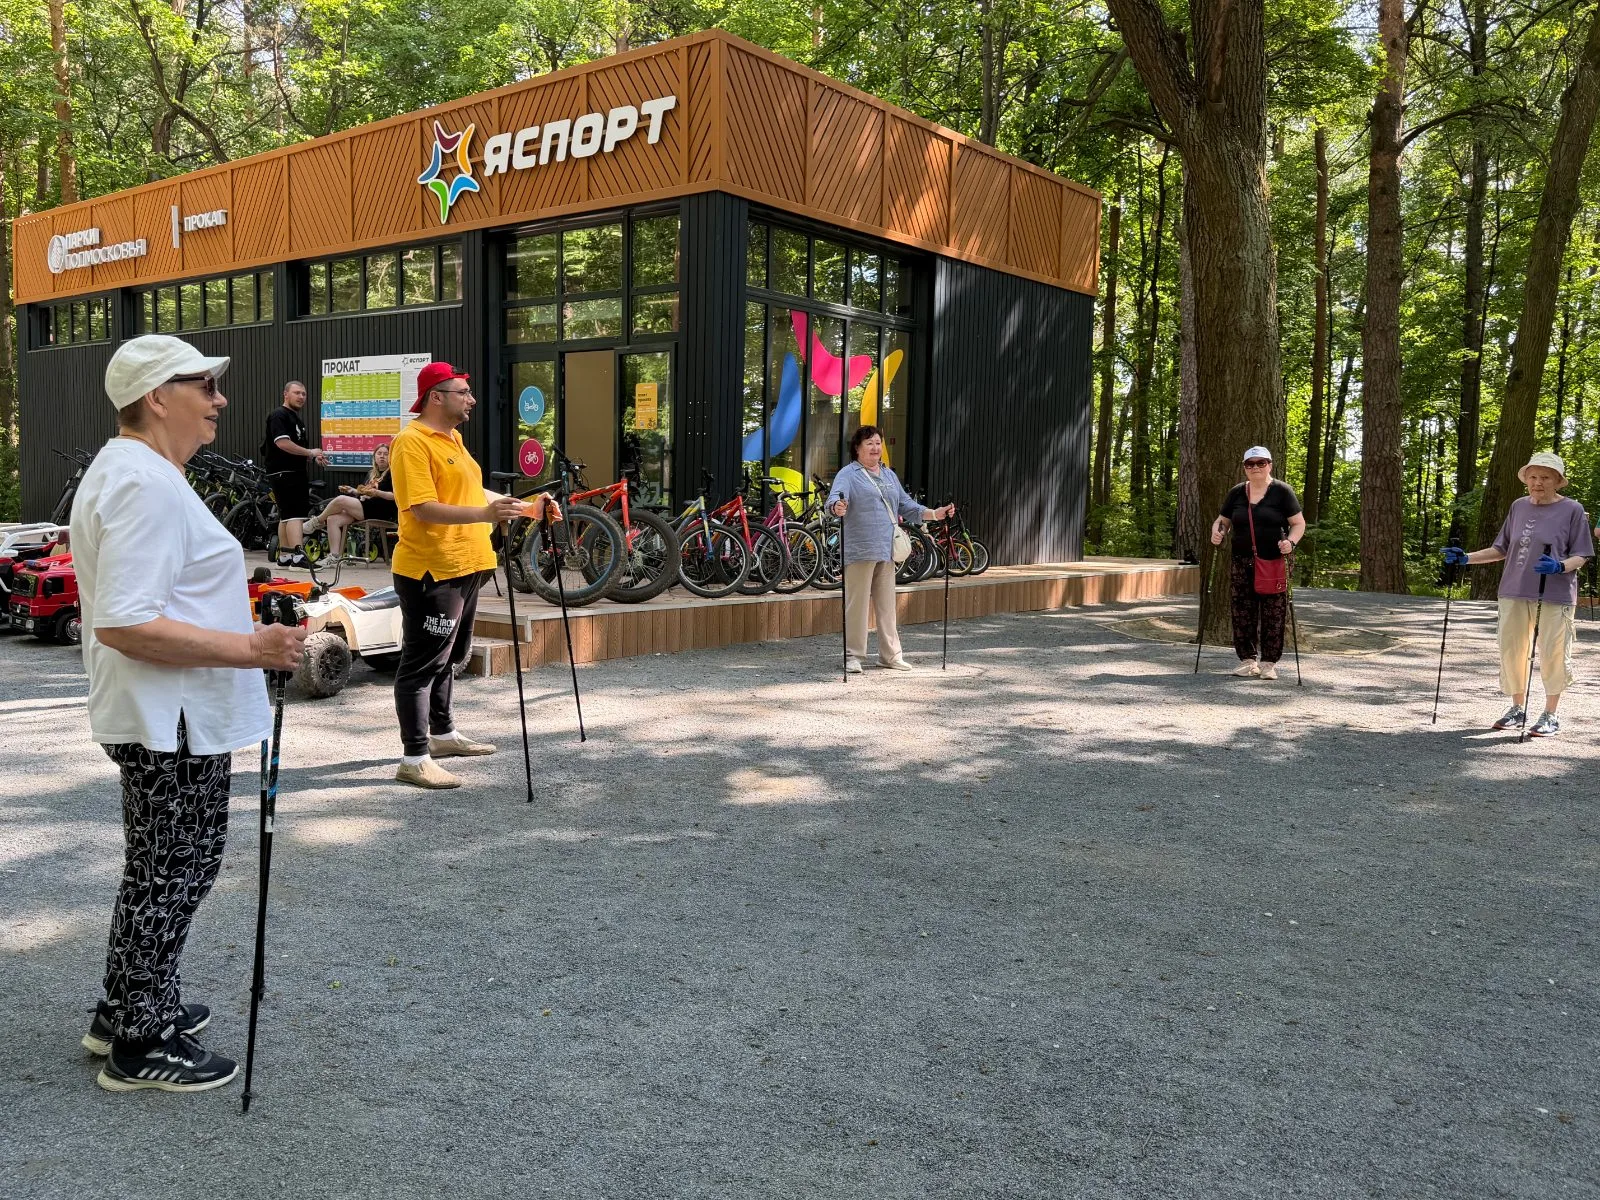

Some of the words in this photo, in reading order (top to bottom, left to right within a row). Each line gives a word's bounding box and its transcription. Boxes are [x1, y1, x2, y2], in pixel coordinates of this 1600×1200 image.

[483, 95, 677, 177] ЯСПОРТ
[183, 209, 228, 232] ПРОКАТ
[65, 227, 100, 250] ПАРКИ
[64, 238, 147, 270] ПОДМОСКОВЬЯ
[323, 360, 361, 374] ПРОКАТ
[425, 615, 439, 626] THE
